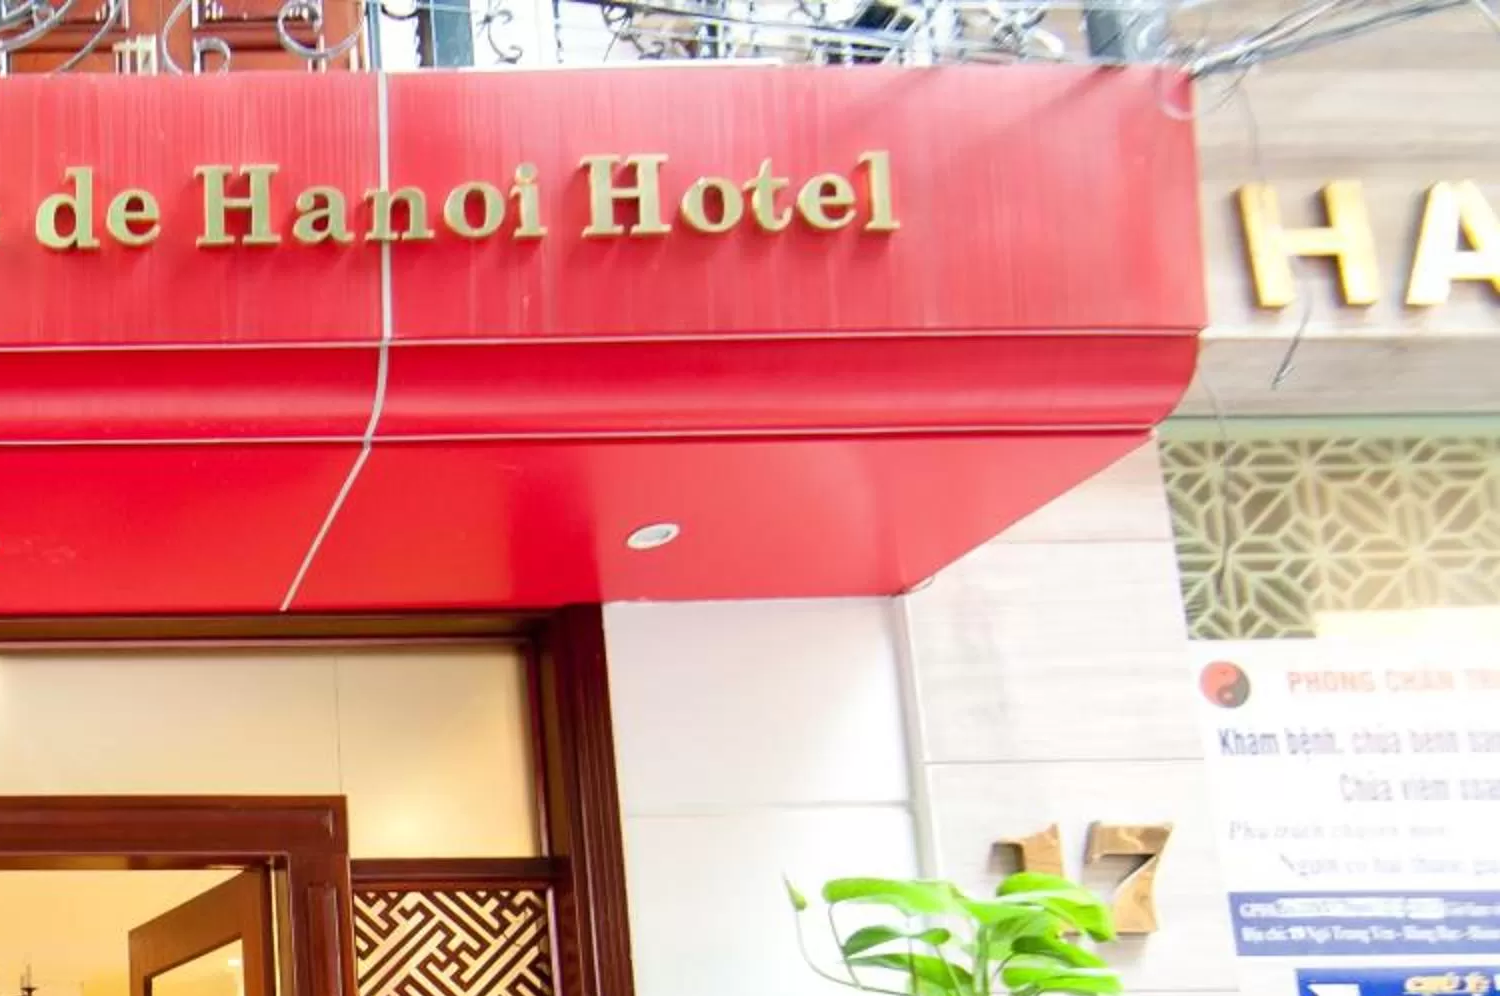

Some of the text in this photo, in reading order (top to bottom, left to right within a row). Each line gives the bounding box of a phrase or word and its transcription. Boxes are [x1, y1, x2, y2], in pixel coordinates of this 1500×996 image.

[34, 166, 162, 249] de
[193, 162, 548, 248] Hanoi
[580, 150, 901, 238] Hotel
[1238, 180, 1500, 307] HA
